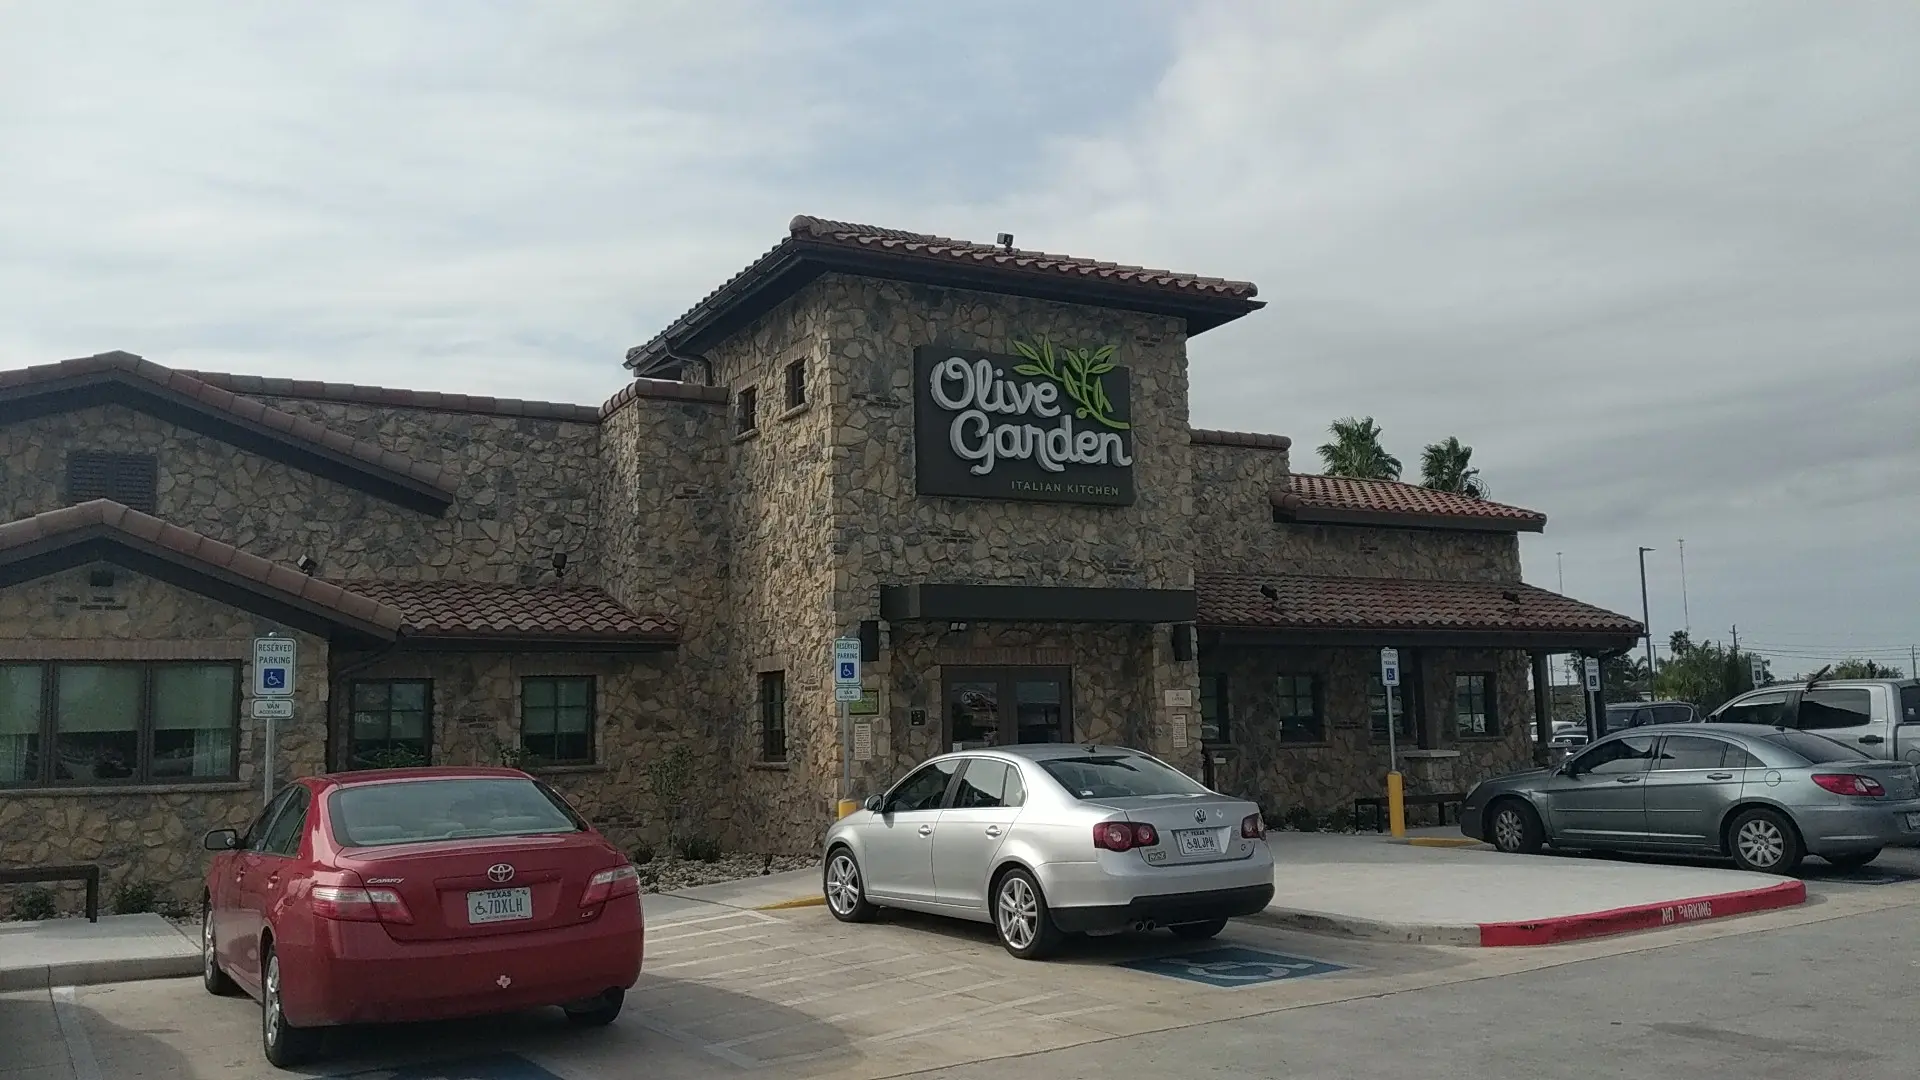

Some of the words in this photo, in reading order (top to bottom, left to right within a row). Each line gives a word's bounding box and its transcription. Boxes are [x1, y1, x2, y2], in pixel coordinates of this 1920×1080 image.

[930, 356, 1061, 418] Olive
[950, 409, 1133, 476] Garden
[1011, 480, 1061, 493] ITALIAN
[1067, 484, 1119, 496] KITCHEN
[257, 643, 293, 653] RESERVED
[836, 642, 859, 650] RESERVED
[259, 656, 291, 665] PARKING
[837, 652, 858, 660] PARKING
[488, 898, 522, 914] 7DXLH
[1661, 907, 1674, 924] NO
[1678, 902, 1712, 919] PARKING
